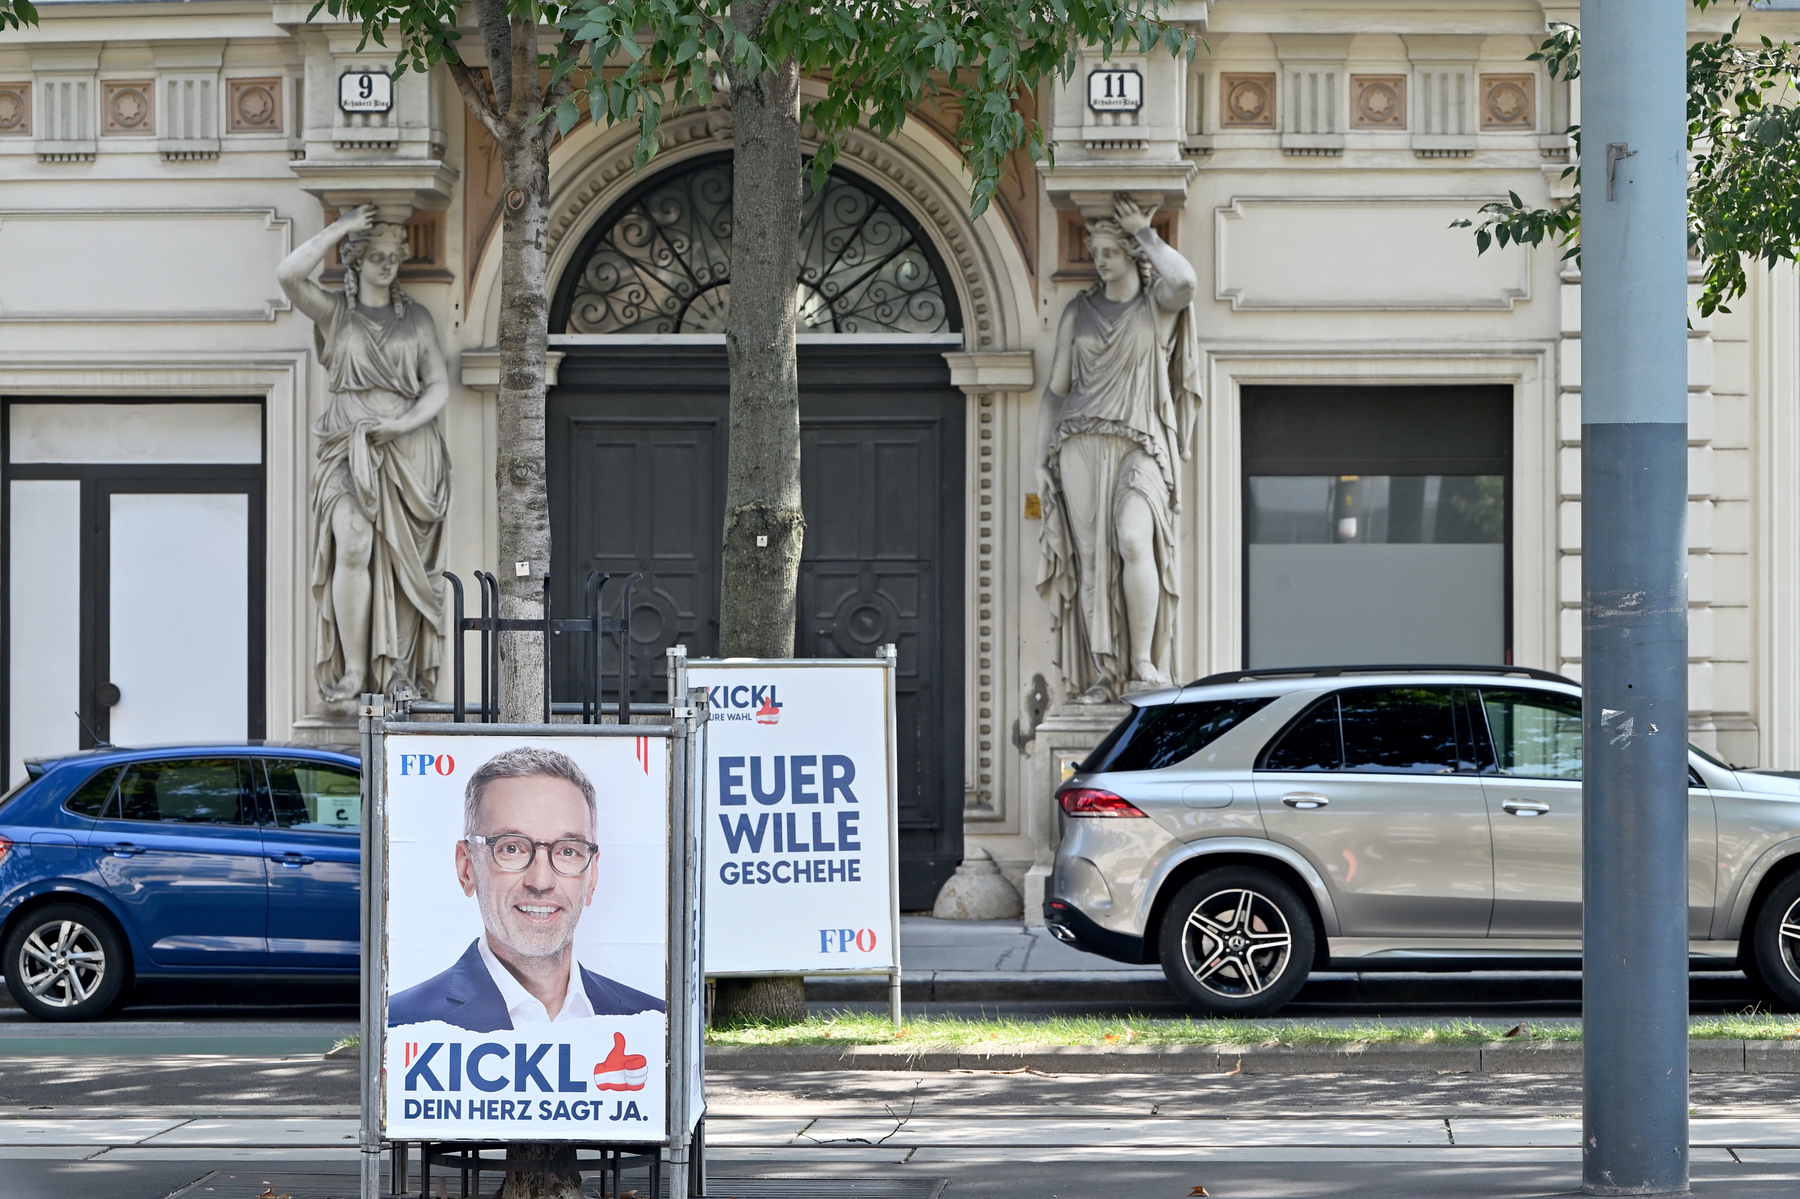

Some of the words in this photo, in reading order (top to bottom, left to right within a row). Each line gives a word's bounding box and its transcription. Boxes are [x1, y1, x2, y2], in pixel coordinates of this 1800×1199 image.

[359, 74, 373, 99] 9
[1104, 74, 1126, 98] 11
[708, 685, 783, 709] KICKL
[726, 713, 752, 721] WAHL
[718, 754, 859, 806] EUER
[718, 811, 861, 854] WILLE
[719, 859, 861, 886] GESCHEHE
[404, 1042, 587, 1093] KICKL
[404, 1098, 462, 1120] DEIN
[468, 1099, 532, 1120] HERZ
[538, 1100, 604, 1121] SAGT
[609, 1100, 649, 1122] JA.
